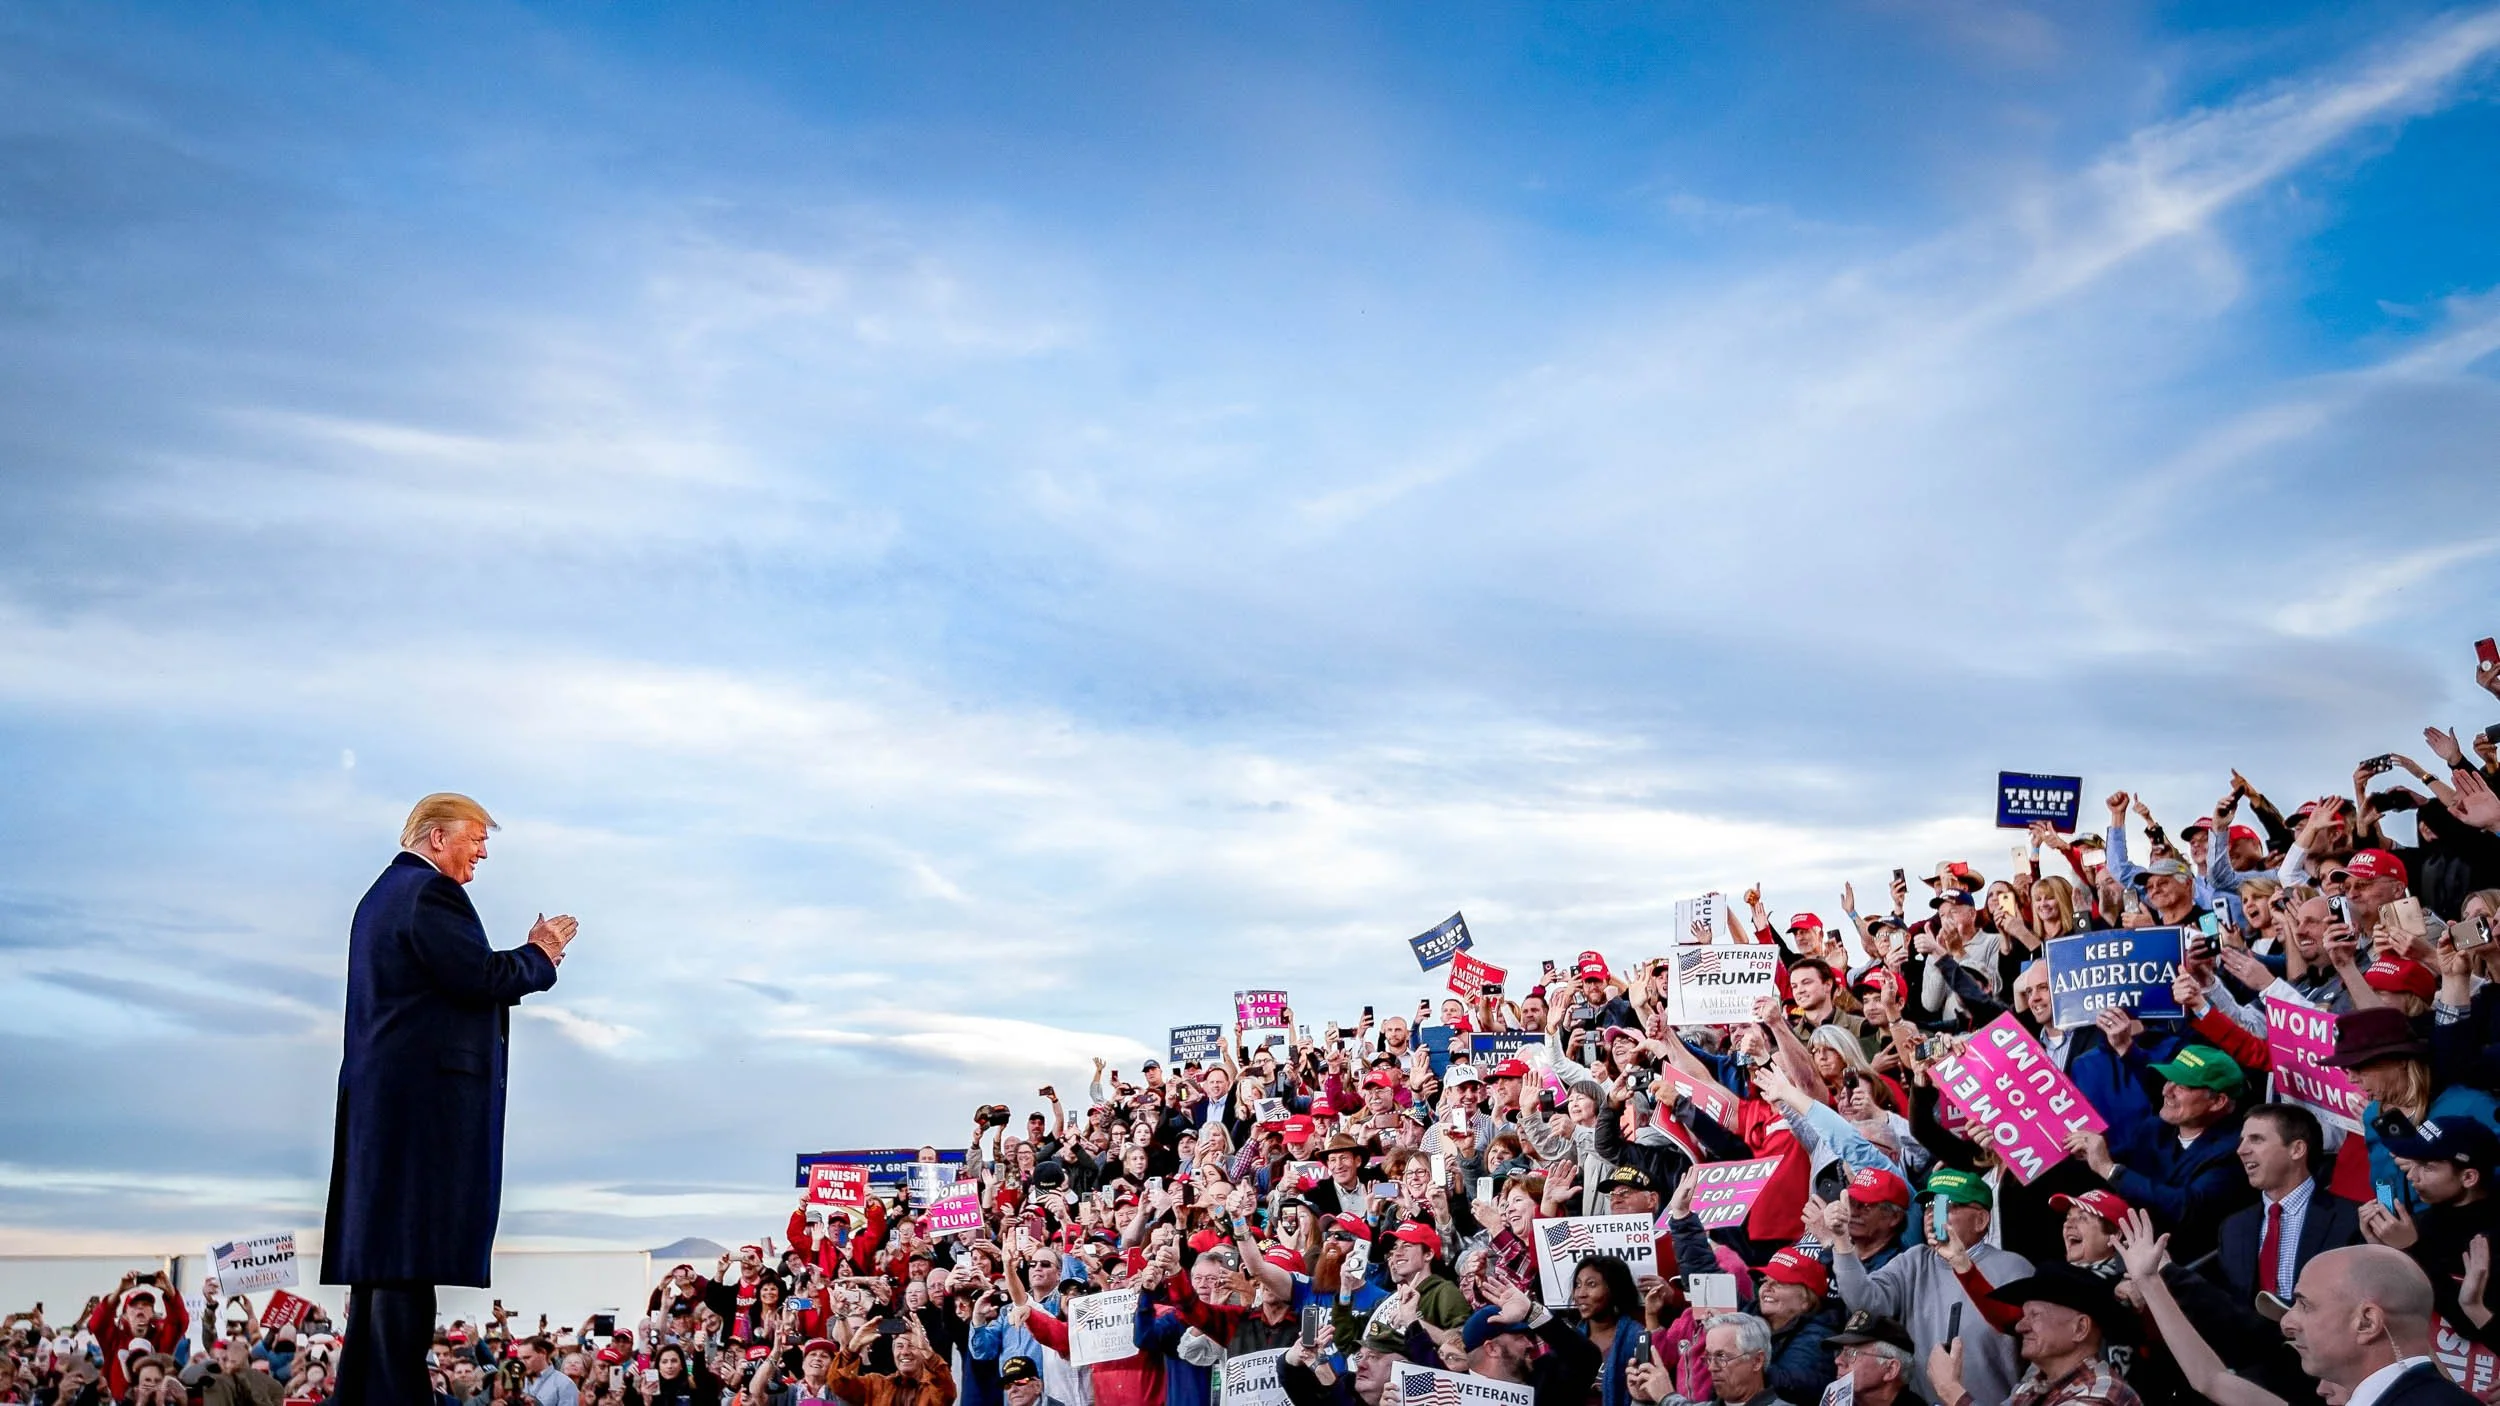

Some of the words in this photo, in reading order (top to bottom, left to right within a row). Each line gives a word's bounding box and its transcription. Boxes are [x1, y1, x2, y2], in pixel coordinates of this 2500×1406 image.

[2004, 787, 2074, 803] TRUMP
[2010, 799, 2067, 811] PENCE
[1417, 923, 1463, 954] TRUMP
[1717, 951, 1774, 960] VETERANS
[2085, 940, 2134, 961] KEEP
[1466, 962, 1486, 977] MAKE
[1750, 961, 1772, 970] FOR
[1451, 966, 1493, 986] AMERI
[1695, 972, 1772, 987] TRUMP
[2053, 960, 2177, 995] AMERICA
[1235, 993, 1287, 1005] WOMEN
[1700, 996, 1756, 1009] AMERIC
[2083, 990, 2142, 1012] GREAT
[1251, 1006, 1271, 1015] FOR
[1239, 1015, 1282, 1029] TRUM
[2266, 1003, 2340, 1047] WOM
[1174, 1027, 1217, 1039] PROMISES
[1182, 1035, 1208, 1044] MADE
[1174, 1043, 1217, 1055] PROMISES
[1495, 1040, 1522, 1050] MAKE
[1182, 1051, 1206, 1060] KEPT
[1455, 1066, 1475, 1077] USA
[1990, 1028, 2089, 1133] TRUMP
[1995, 1072, 2038, 1121] FOR
[1935, 1055, 2043, 1180] WOMEN
[817, 1169, 861, 1182] FINISH
[829, 1180, 844, 1189] THE
[817, 1187, 857, 1201] WALL
[1700, 1188, 1734, 1202] FOR
[943, 1200, 962, 1211] FOR
[930, 1211, 979, 1229] TRUMP
[1587, 1221, 1649, 1233] VETERANS
[246, 1235, 294, 1249] VETERANS
[1626, 1233, 1650, 1243] FOR
[275, 1242, 294, 1252] FOR
[230, 1250, 295, 1270] TRUMP
[1240, 1355, 1279, 1369] VETERA
[2471, 1353, 2495, 1393] THE
[1227, 1376, 1281, 1397] TRUM
[1456, 1381, 1529, 1405] VETERANS
